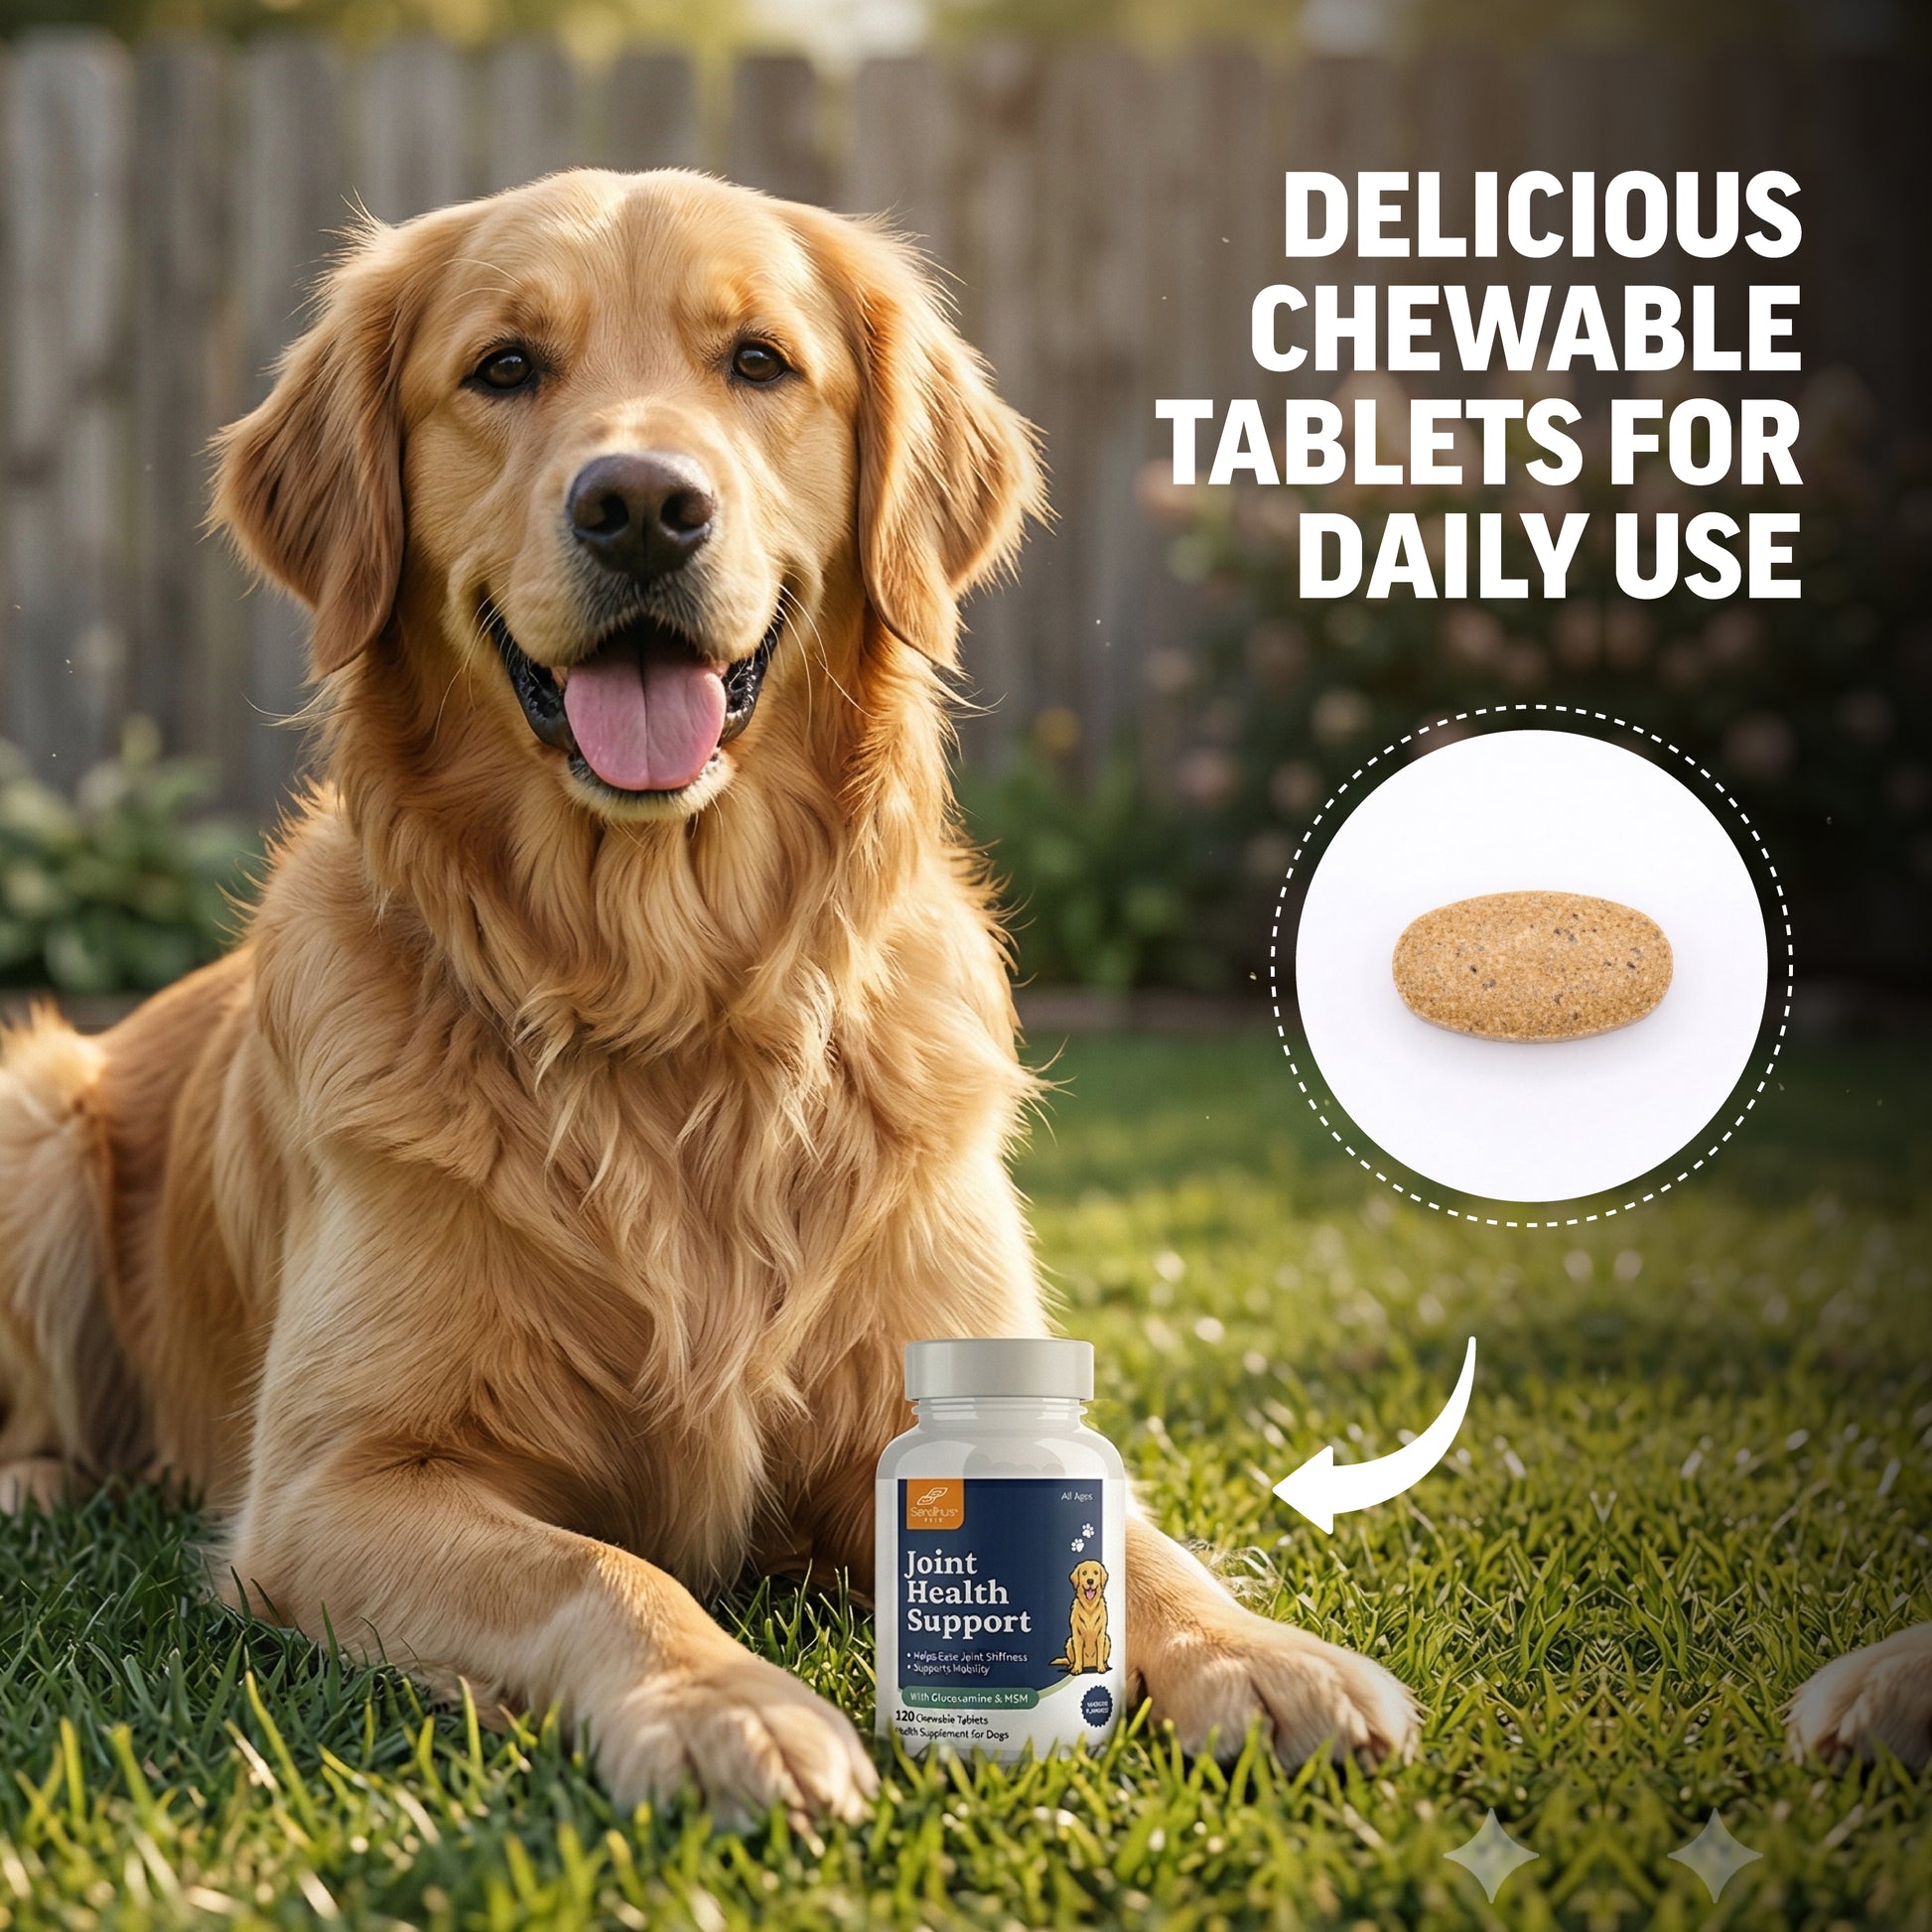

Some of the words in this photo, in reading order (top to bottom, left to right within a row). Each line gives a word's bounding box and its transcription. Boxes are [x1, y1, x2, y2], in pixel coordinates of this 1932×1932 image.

[1061, 1491, 1072, 1500] All
[903, 1549, 978, 1579] Joint
[906, 1580, 1010, 1604] Health
[906, 1608, 1032, 1640] Support
[960, 1652, 984, 1663] Joint
[986, 1651, 1028, 1662] Stiffness
[913, 1663, 952, 1676] Supports
[910, 1692, 929, 1702] With
[994, 1694, 1003, 1704] &
[1004, 1694, 1029, 1704] MSM
[896, 1710, 914, 1723] 120
[919, 1727, 969, 1739] Supplement
[972, 1728, 984, 1738] for
[987, 1729, 1010, 1741] Dogs
